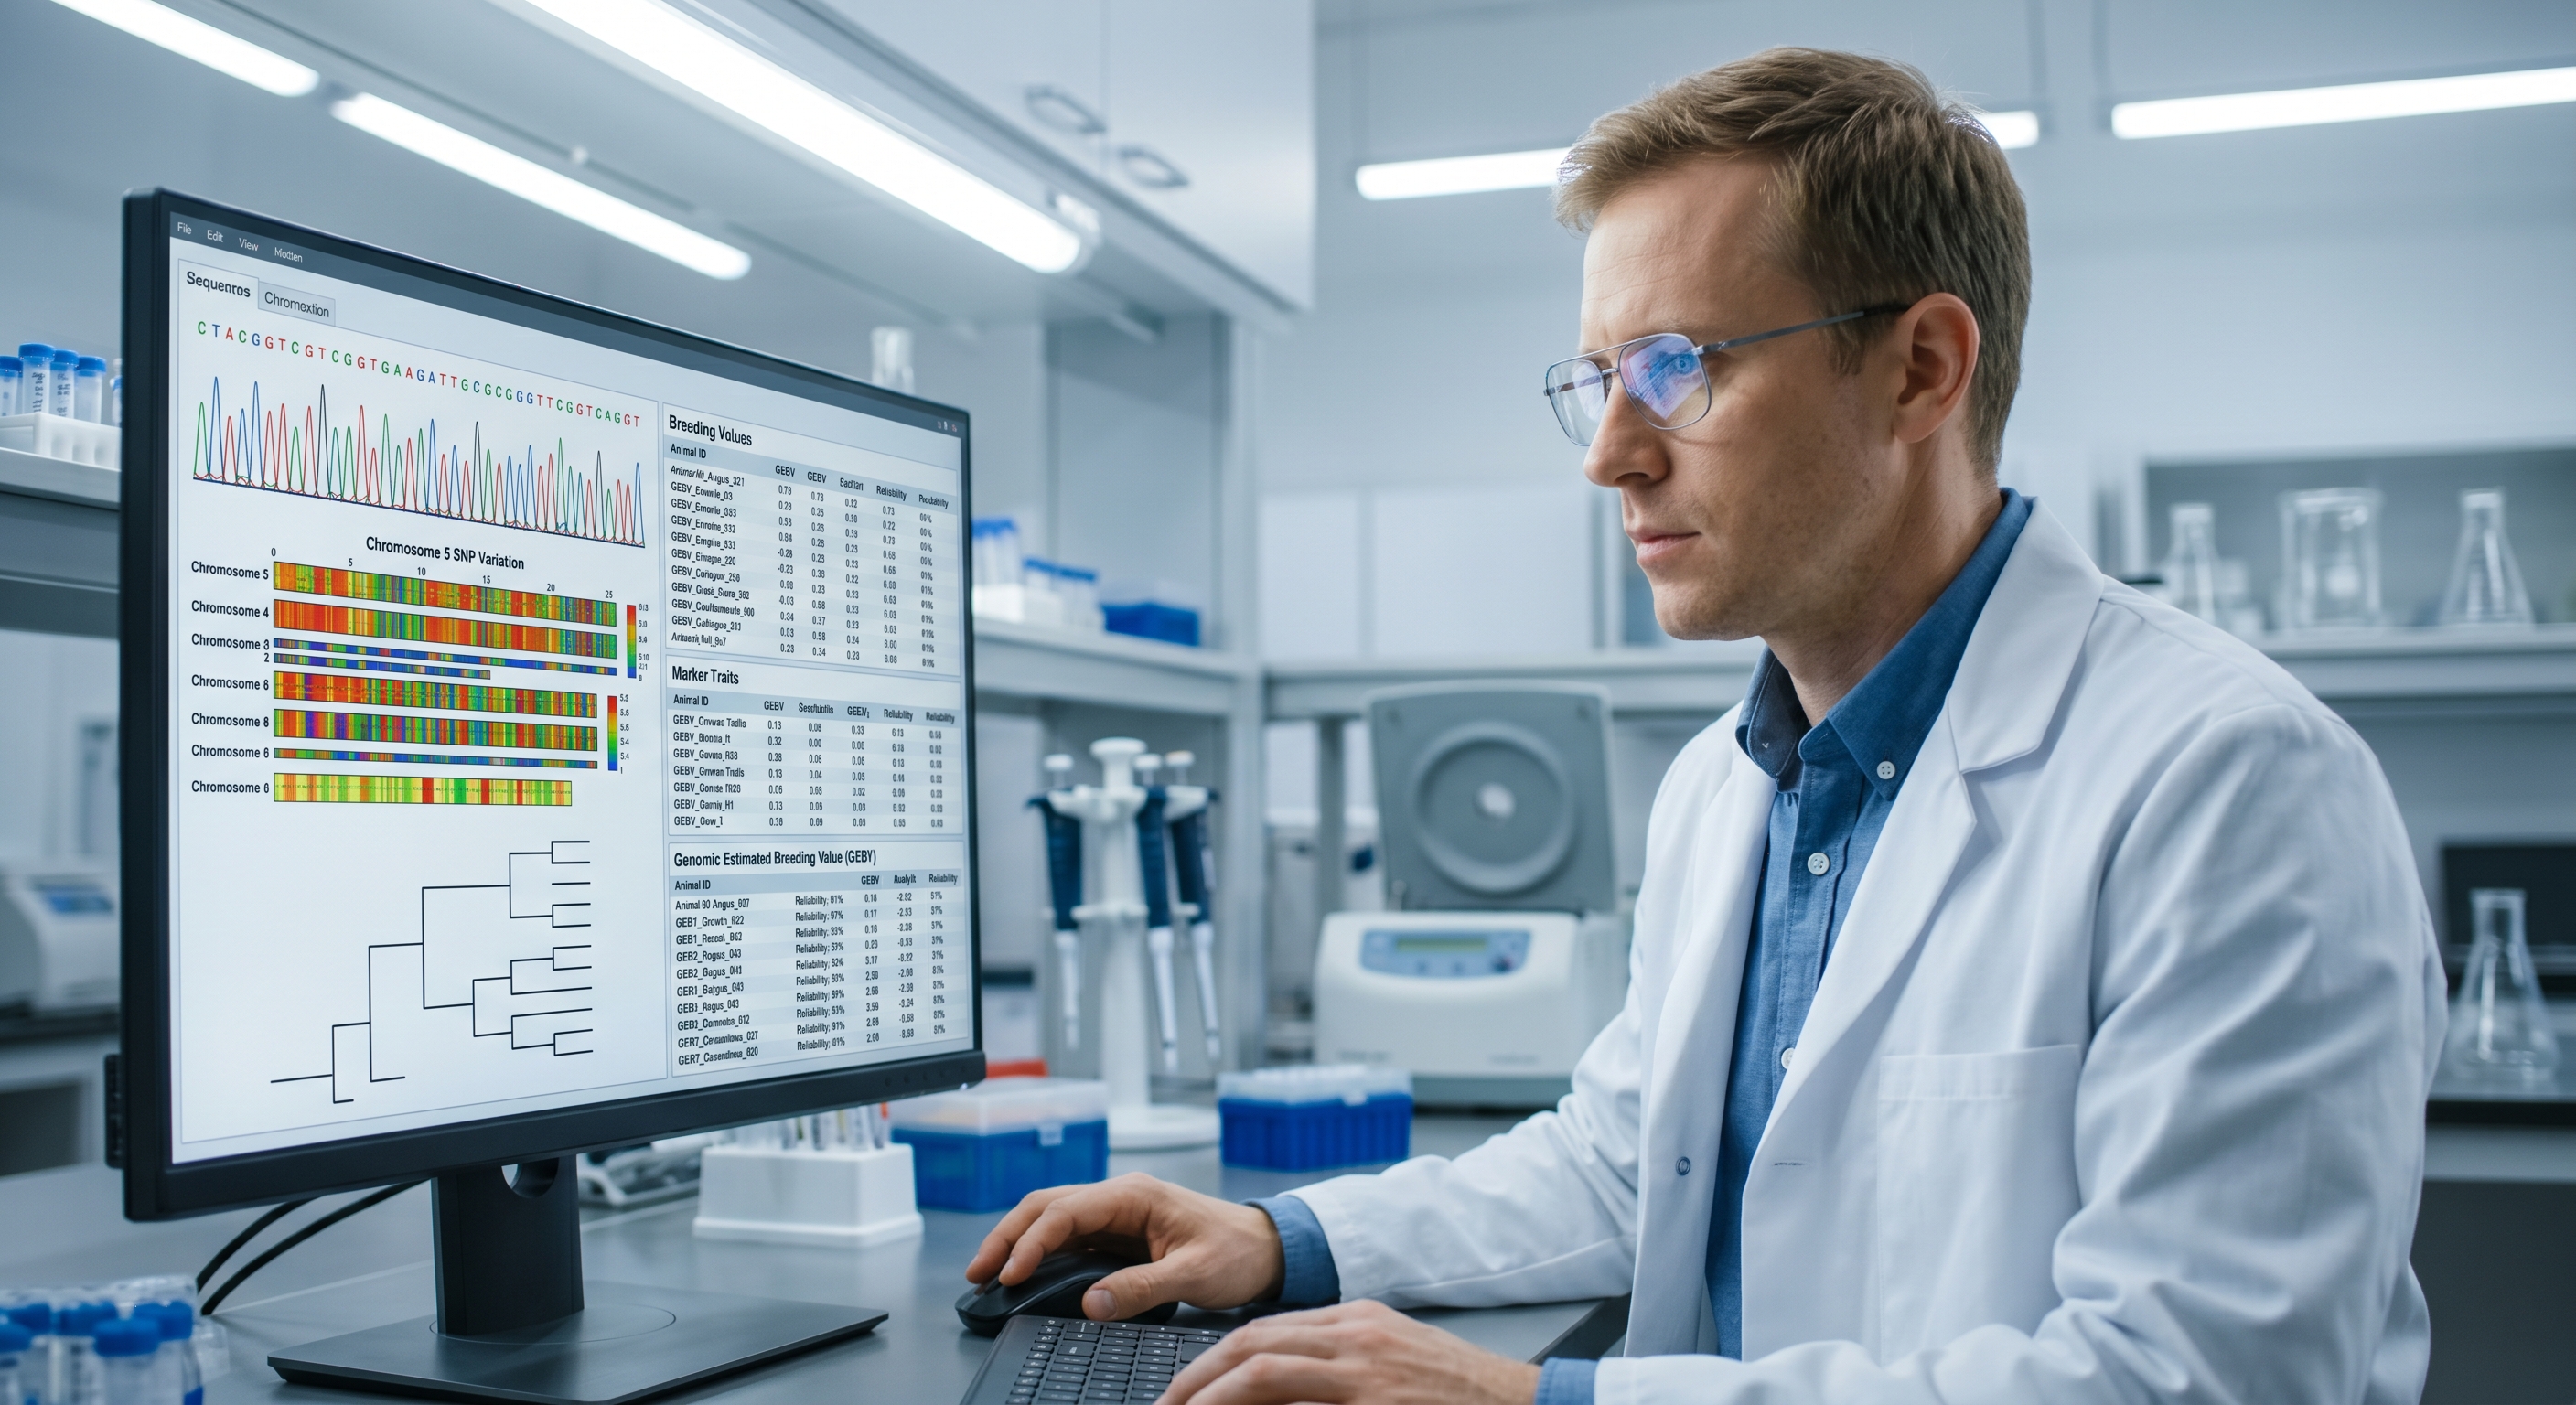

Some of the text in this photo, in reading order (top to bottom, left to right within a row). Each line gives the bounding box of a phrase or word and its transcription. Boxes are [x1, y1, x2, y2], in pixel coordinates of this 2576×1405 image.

[178, 222, 191, 234] File
[208, 230, 223, 242] Edit
[239, 238, 258, 251] View
[670, 414, 715, 441] Breeding
[671, 444, 706, 458] Animal ID
[776, 465, 795, 477] GEBV
[808, 471, 826, 483] GEBV
[367, 537, 524, 569] Chromosome 5 SNP Variation
[191, 561, 268, 580] Chromosome 5
[271, 548, 613, 598] 0 5 10 15 20 25
[192, 600, 269, 617] Chromosome 4
[192, 634, 260, 649] Chromosome
[264, 653, 269, 662] 2
[192, 674, 260, 690] Chromosome
[672, 666, 738, 684] Marker Traits
[673, 694, 699, 705] Animal
[702, 696, 708, 705] ID
[764, 701, 784, 711] GEBV
[192, 713, 260, 726] Chromosome
[192, 745, 260, 757] Chromosome
[192, 780, 260, 793] Chromosome
[674, 853, 720, 866] Genomic
[724, 852, 771, 865] Estimated
[775, 851, 815, 867] Breeding
[818, 851, 843, 863] Value
[675, 880, 701, 890] Animal
[703, 880, 711, 889] ID
